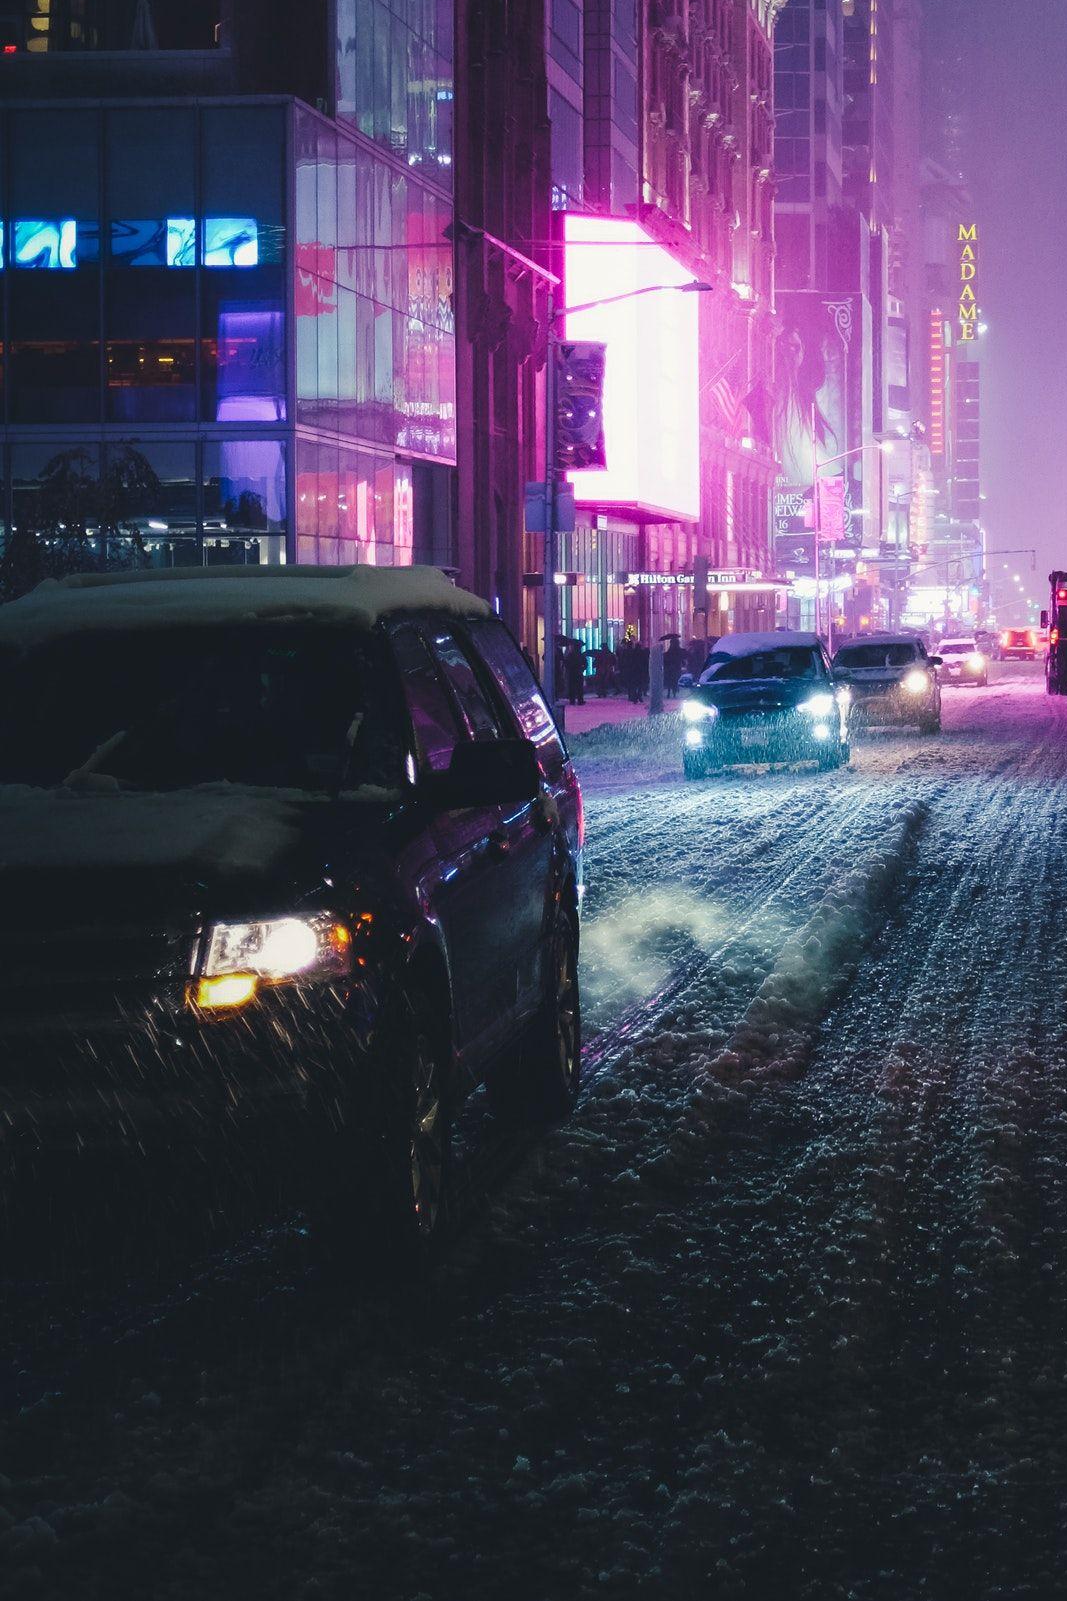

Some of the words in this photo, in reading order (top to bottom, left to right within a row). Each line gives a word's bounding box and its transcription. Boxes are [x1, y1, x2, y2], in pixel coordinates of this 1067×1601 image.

[957, 223, 977, 340] MADAME
[640, 574, 676, 584] Hilton
[676, 574, 715, 584] Garn
[717, 573, 736, 583] Inn
